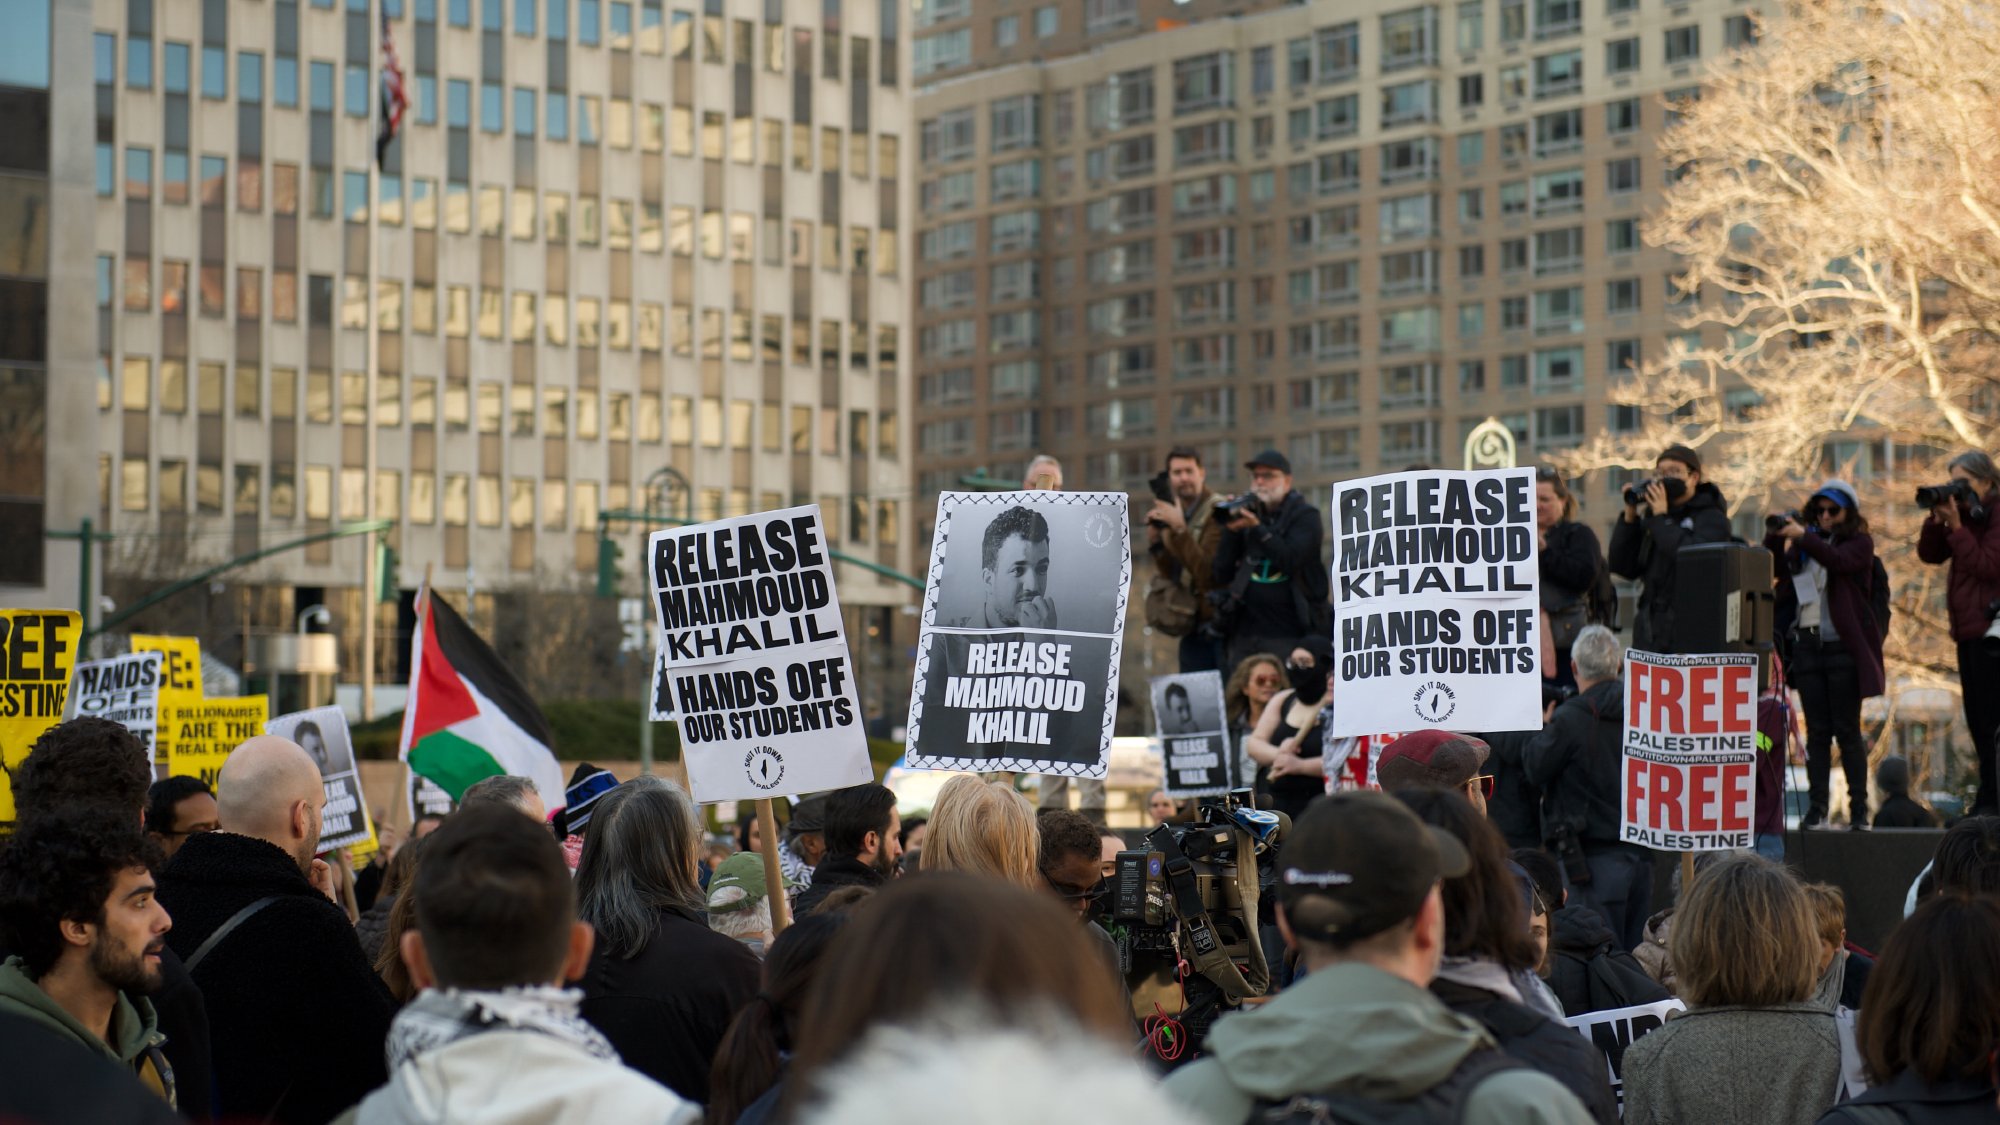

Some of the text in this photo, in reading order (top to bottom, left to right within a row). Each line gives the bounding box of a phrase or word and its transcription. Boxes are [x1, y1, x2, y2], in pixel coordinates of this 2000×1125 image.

[1340, 476, 1530, 535] RELEASE
[655, 515, 824, 588] RELEASE
[1340, 526, 1531, 572] MAHMOUD
[659, 570, 830, 630] MAHMOUD
[1341, 566, 1532, 602] KHALIL
[667, 614, 838, 660] KHALIL
[1342, 608, 1533, 653] HANDS OFF
[82, 658, 156, 694] HANDS
[967, 642, 1072, 676] RELEASE
[1342, 646, 1534, 682] OUR STUDENTS
[82, 690, 154, 711] OFF
[676, 657, 845, 713] HANDS OFF
[944, 676, 1086, 712] MAHMOUD
[1414, 685, 1426, 701] SHUT
[1436, 682, 1456, 700] DOWN!
[1630, 662, 1752, 734] FREE
[176, 705, 262, 720] BILLIONAIRES
[180, 721, 259, 738] ARE THE
[684, 698, 853, 744] OUR STUDENTS
[966, 711, 1051, 745] KHALIL
[1414, 702, 1455, 722] FOR PALESTINE
[176, 742, 208, 755] REAL
[745, 750, 754, 767] SHUT
[754, 746, 760, 754] IT
[1628, 730, 1751, 752] PALESTINE
[1627, 758, 1750, 832] FREE
[1626, 826, 1749, 849] PALESTINE
